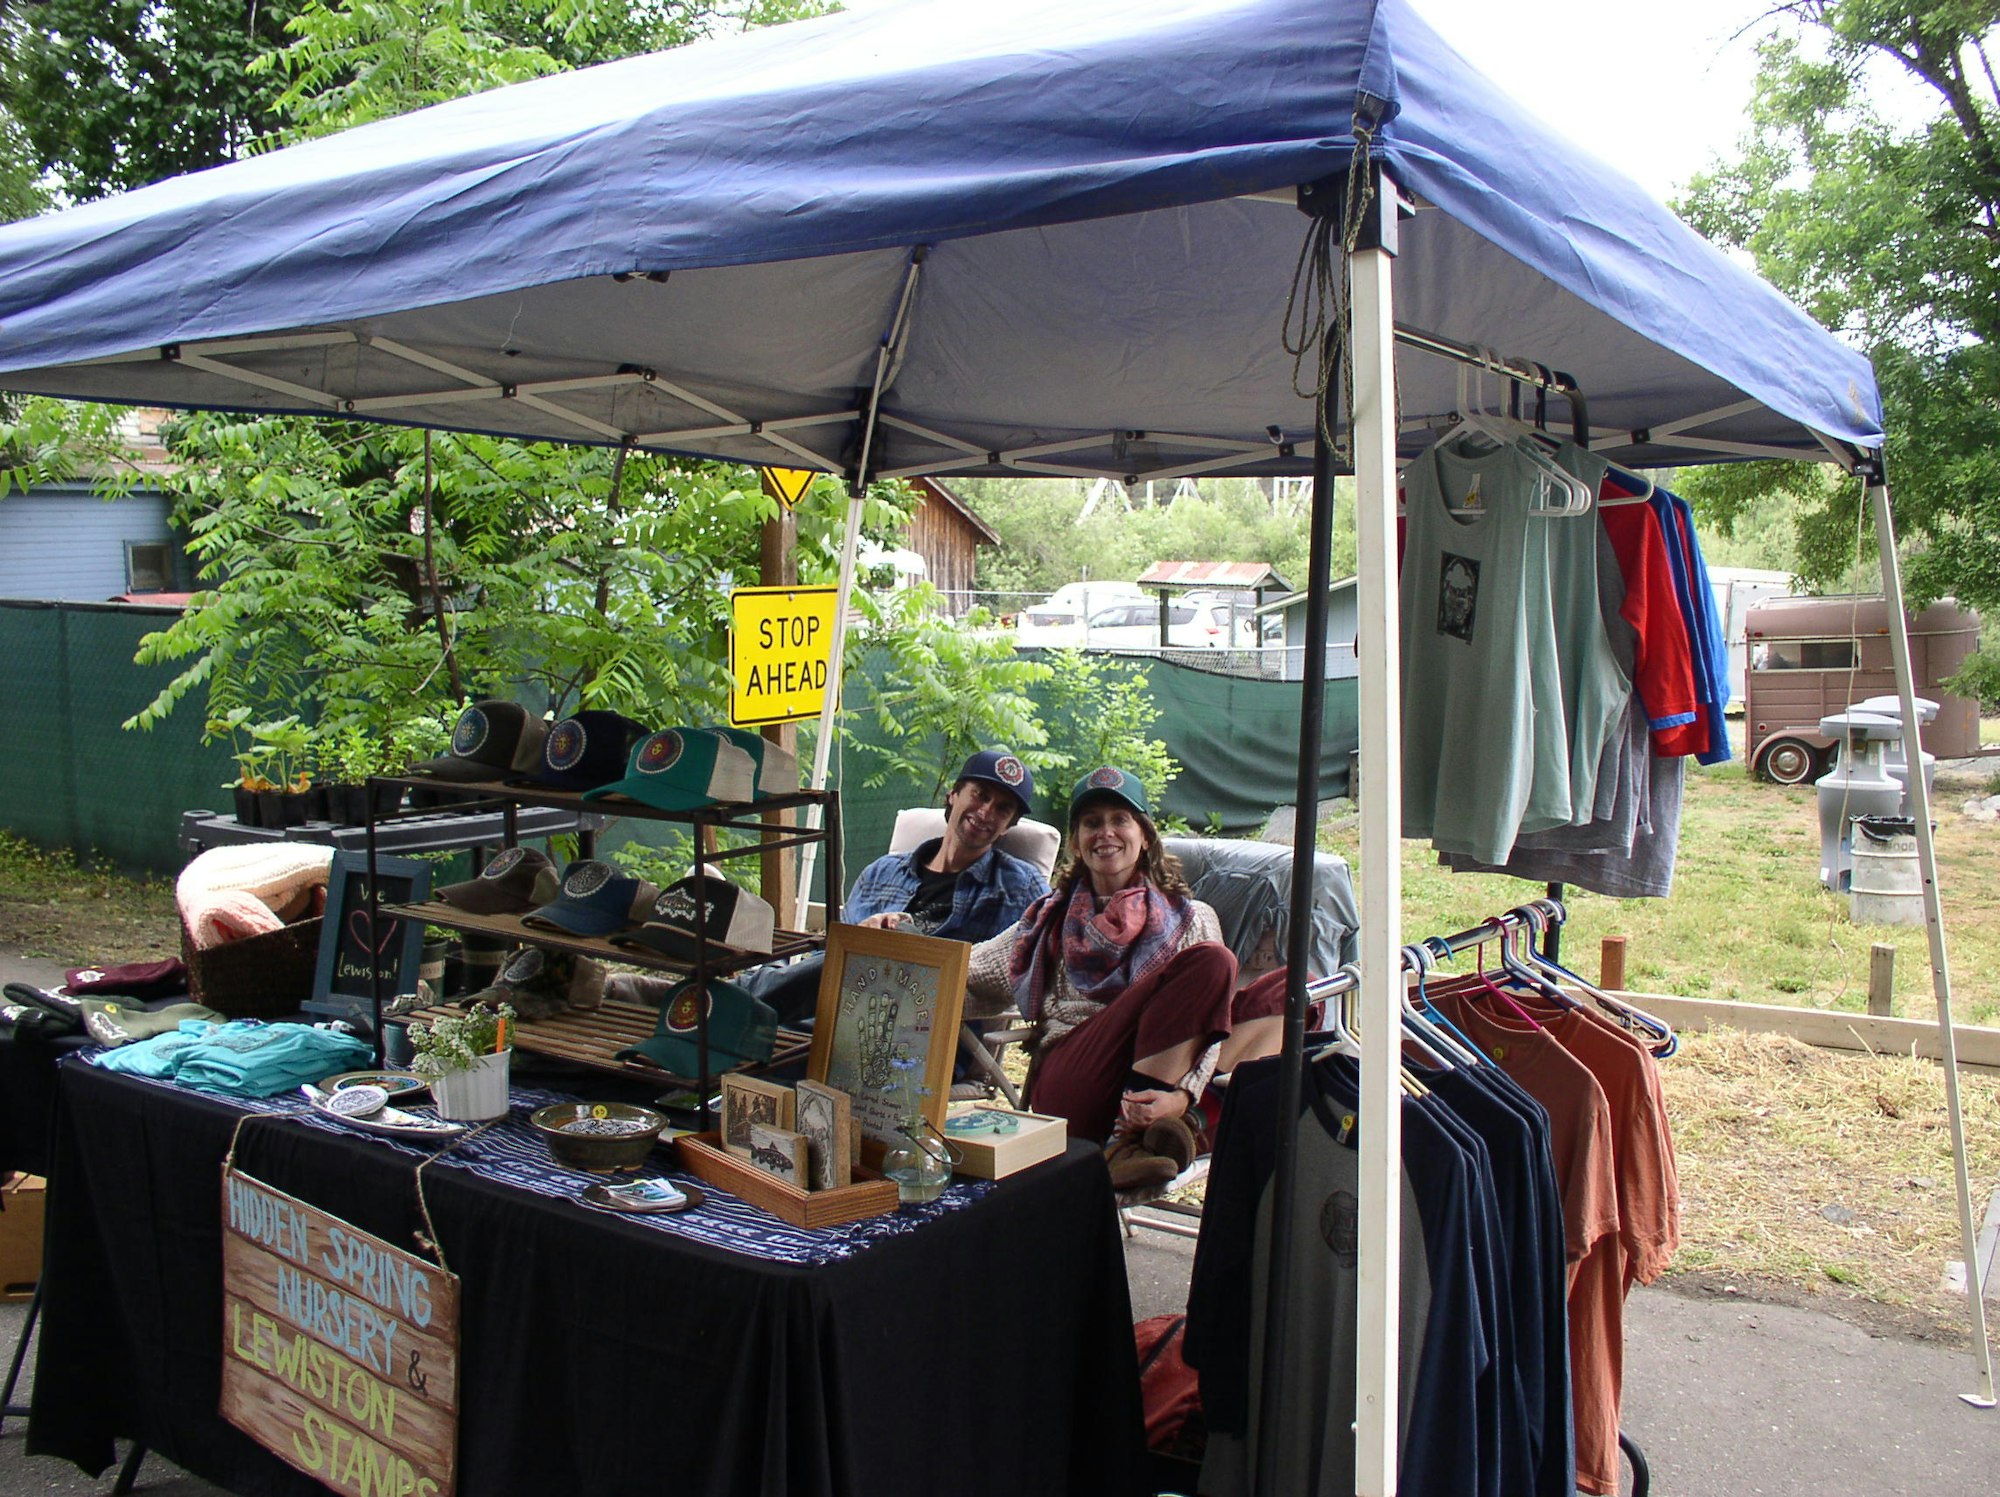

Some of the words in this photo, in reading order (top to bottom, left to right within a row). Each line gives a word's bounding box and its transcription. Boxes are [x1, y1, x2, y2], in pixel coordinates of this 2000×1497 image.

[759, 616, 820, 649] STOP
[746, 659, 828, 697] AHEAD
[339, 953, 397, 979] Lewison!
[843, 968, 876, 1015] HAND
[897, 969, 928, 1021] MADE
[228, 1175, 309, 1265] HIDDEN
[322, 1227, 433, 1329] SPRING
[278, 1266, 397, 1376] NURSERY
[407, 1350, 429, 1396] &
[233, 1304, 397, 1438] LEWISTON
